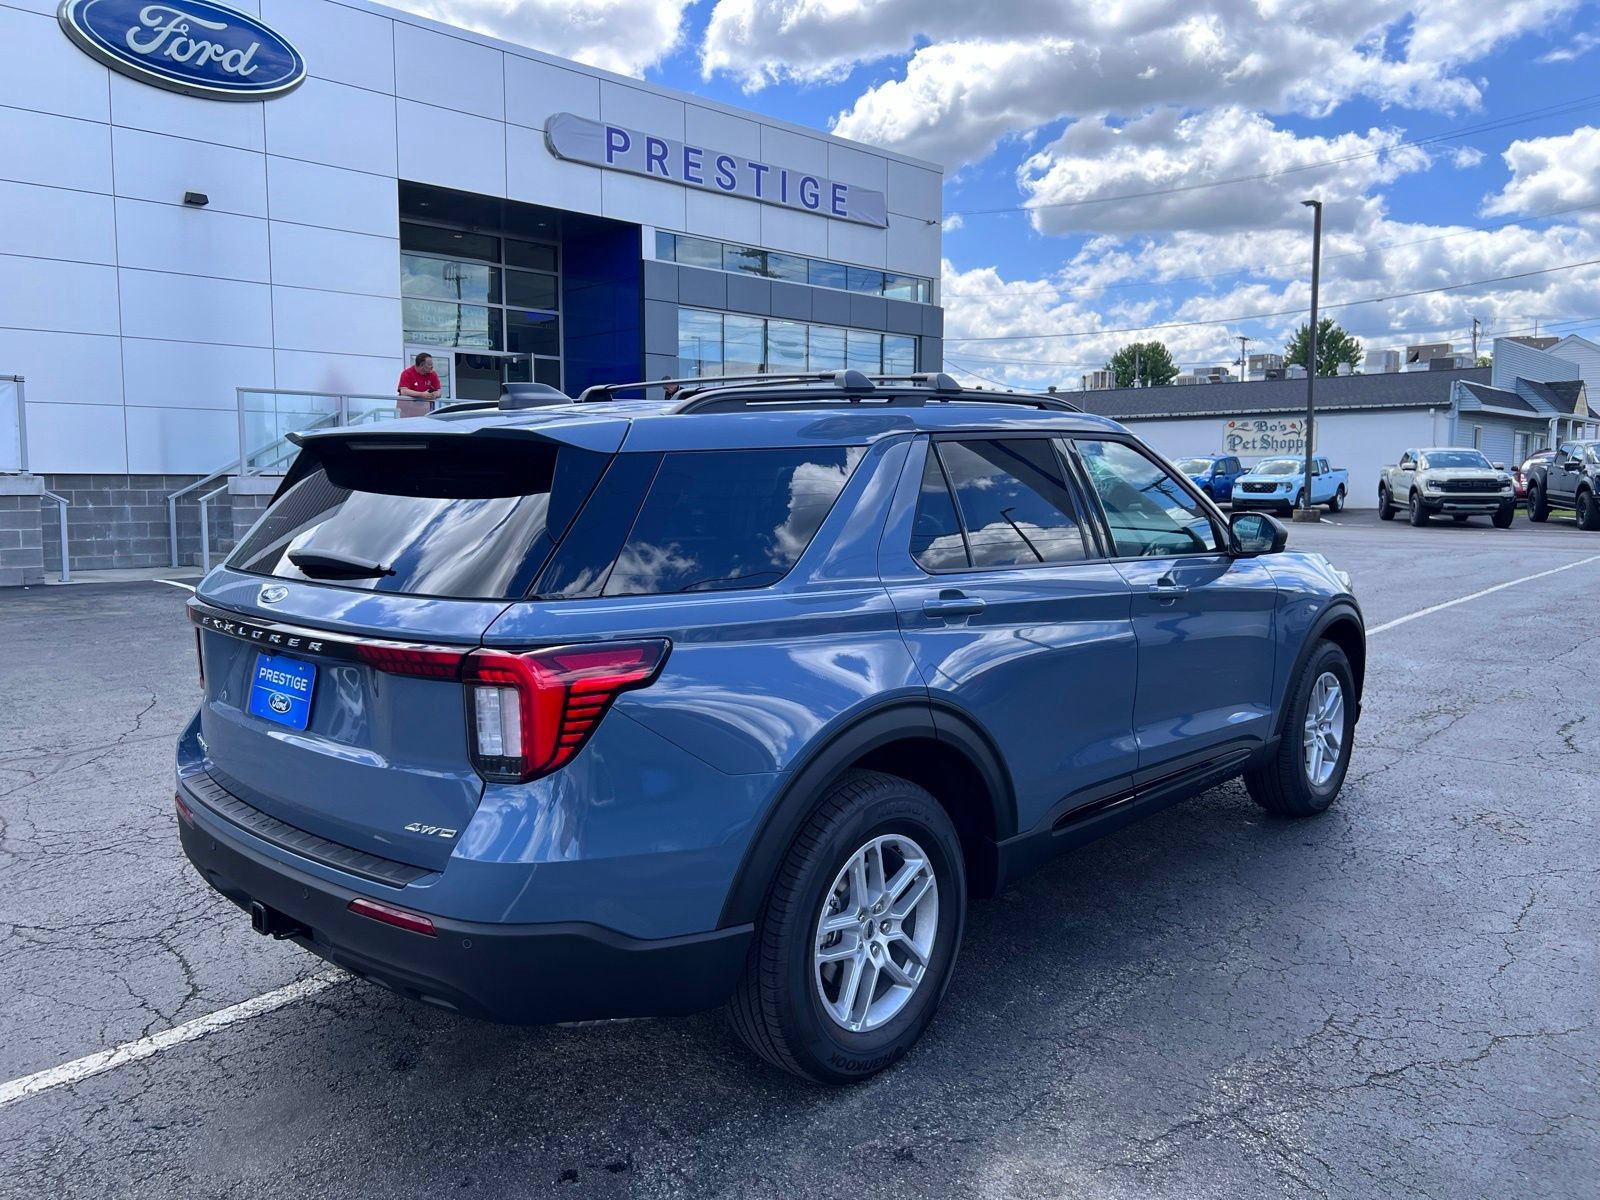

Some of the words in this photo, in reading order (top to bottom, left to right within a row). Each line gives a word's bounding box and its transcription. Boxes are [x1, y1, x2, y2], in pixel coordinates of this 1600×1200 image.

[126, 6, 260, 76] Ford
[604, 125, 849, 217] PRESTIGE
[1253, 420, 1287, 432] Bo's
[1226, 433, 1257, 452] Pet
[1260, 434, 1307, 452] Shopp
[259, 667, 308, 691] PRESTIGE
[272, 694, 288, 710] Ford
[404, 822, 457, 838] 4WD
